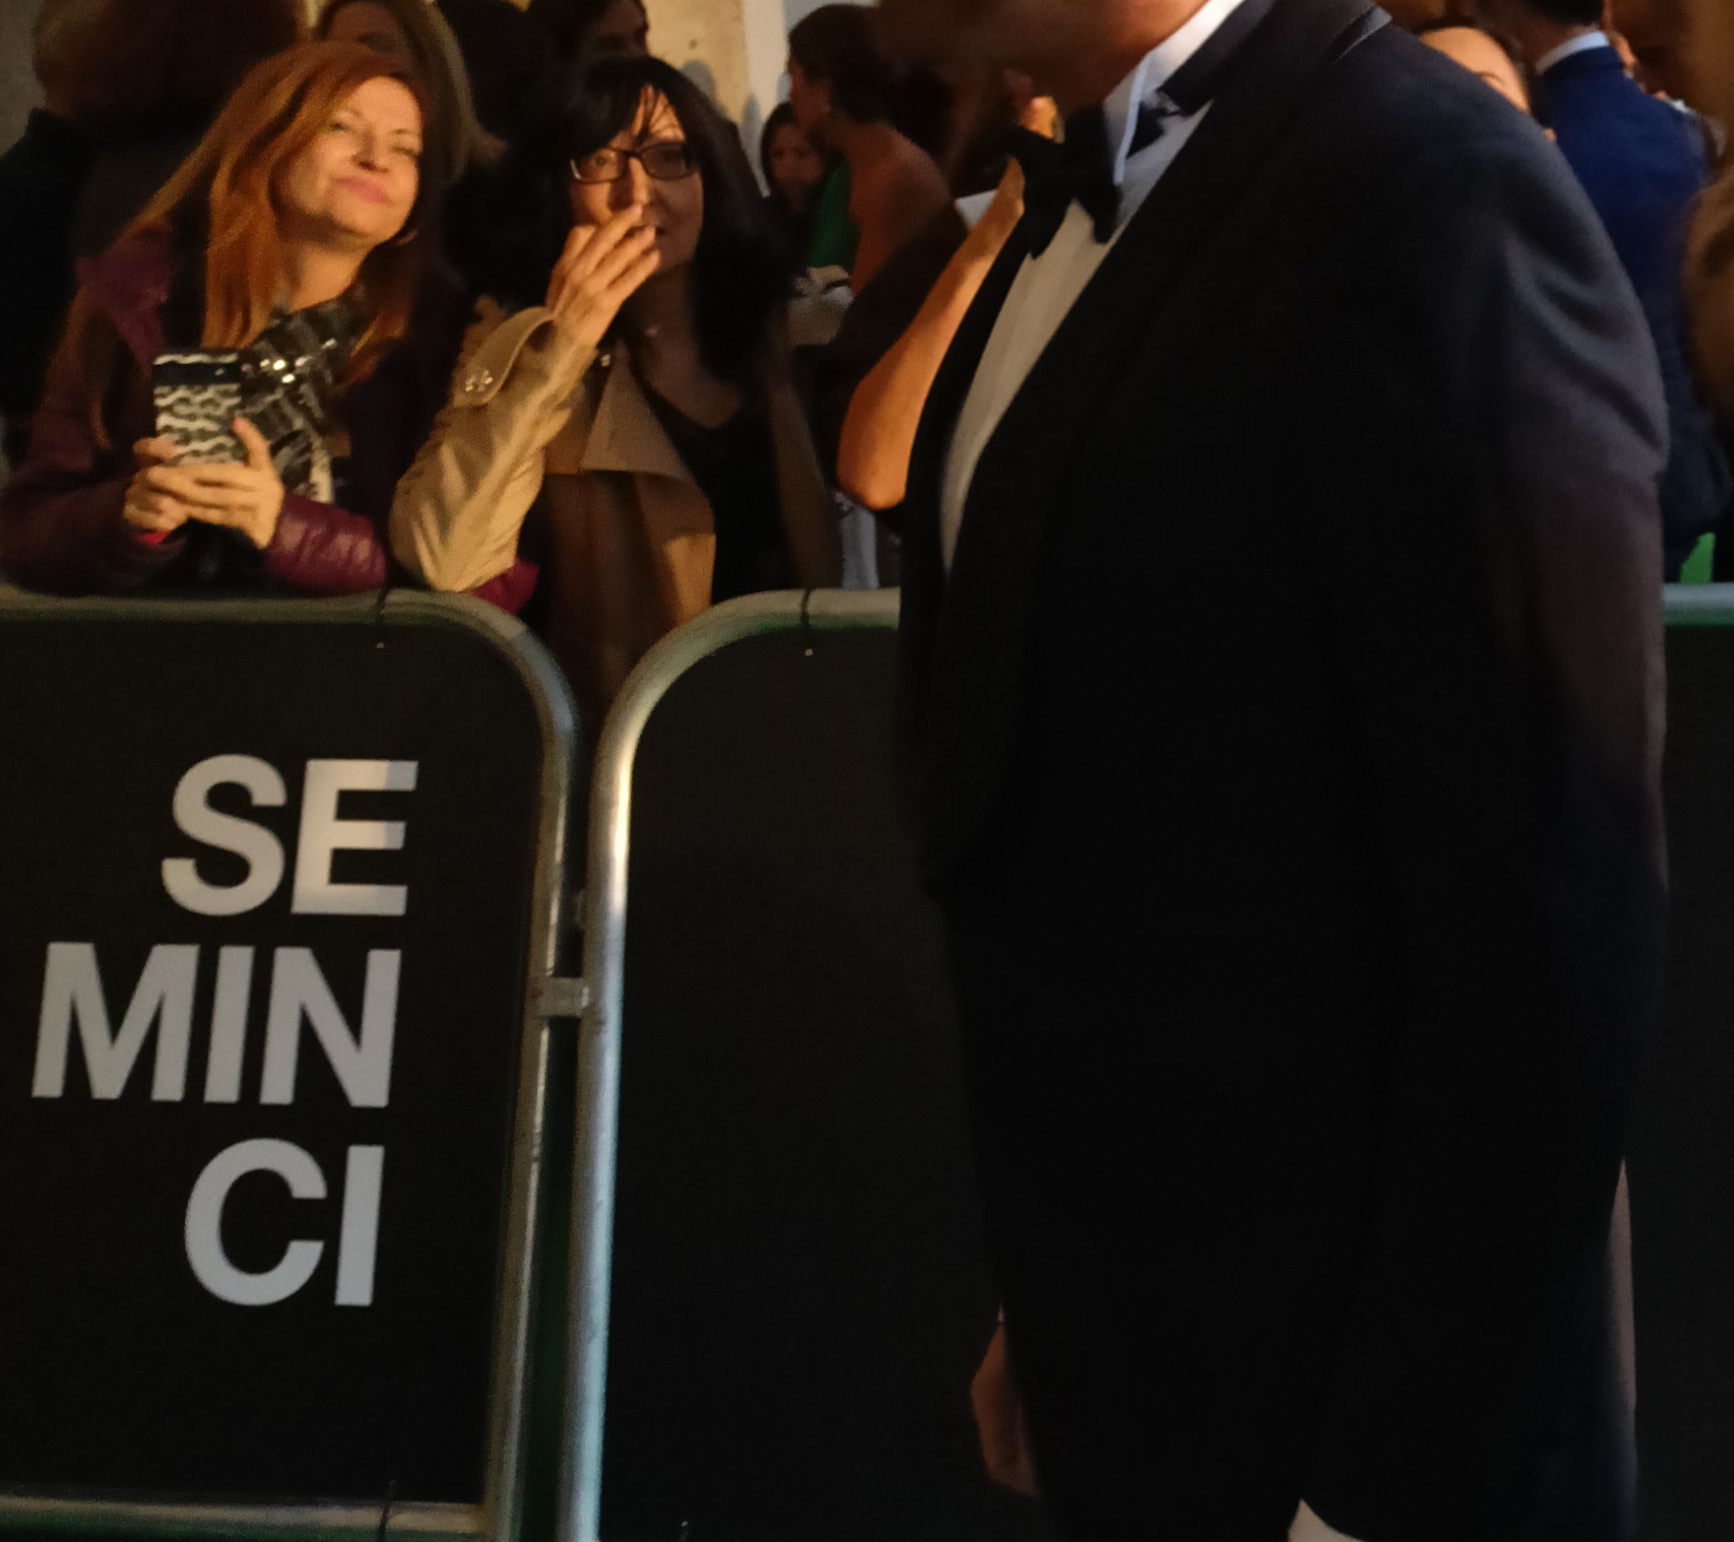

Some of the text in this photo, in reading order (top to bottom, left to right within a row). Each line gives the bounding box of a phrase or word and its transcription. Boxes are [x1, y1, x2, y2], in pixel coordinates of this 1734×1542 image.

[161, 754, 418, 916] SE
[32, 941, 401, 1108] MIN
[184, 1138, 385, 1306] CI
